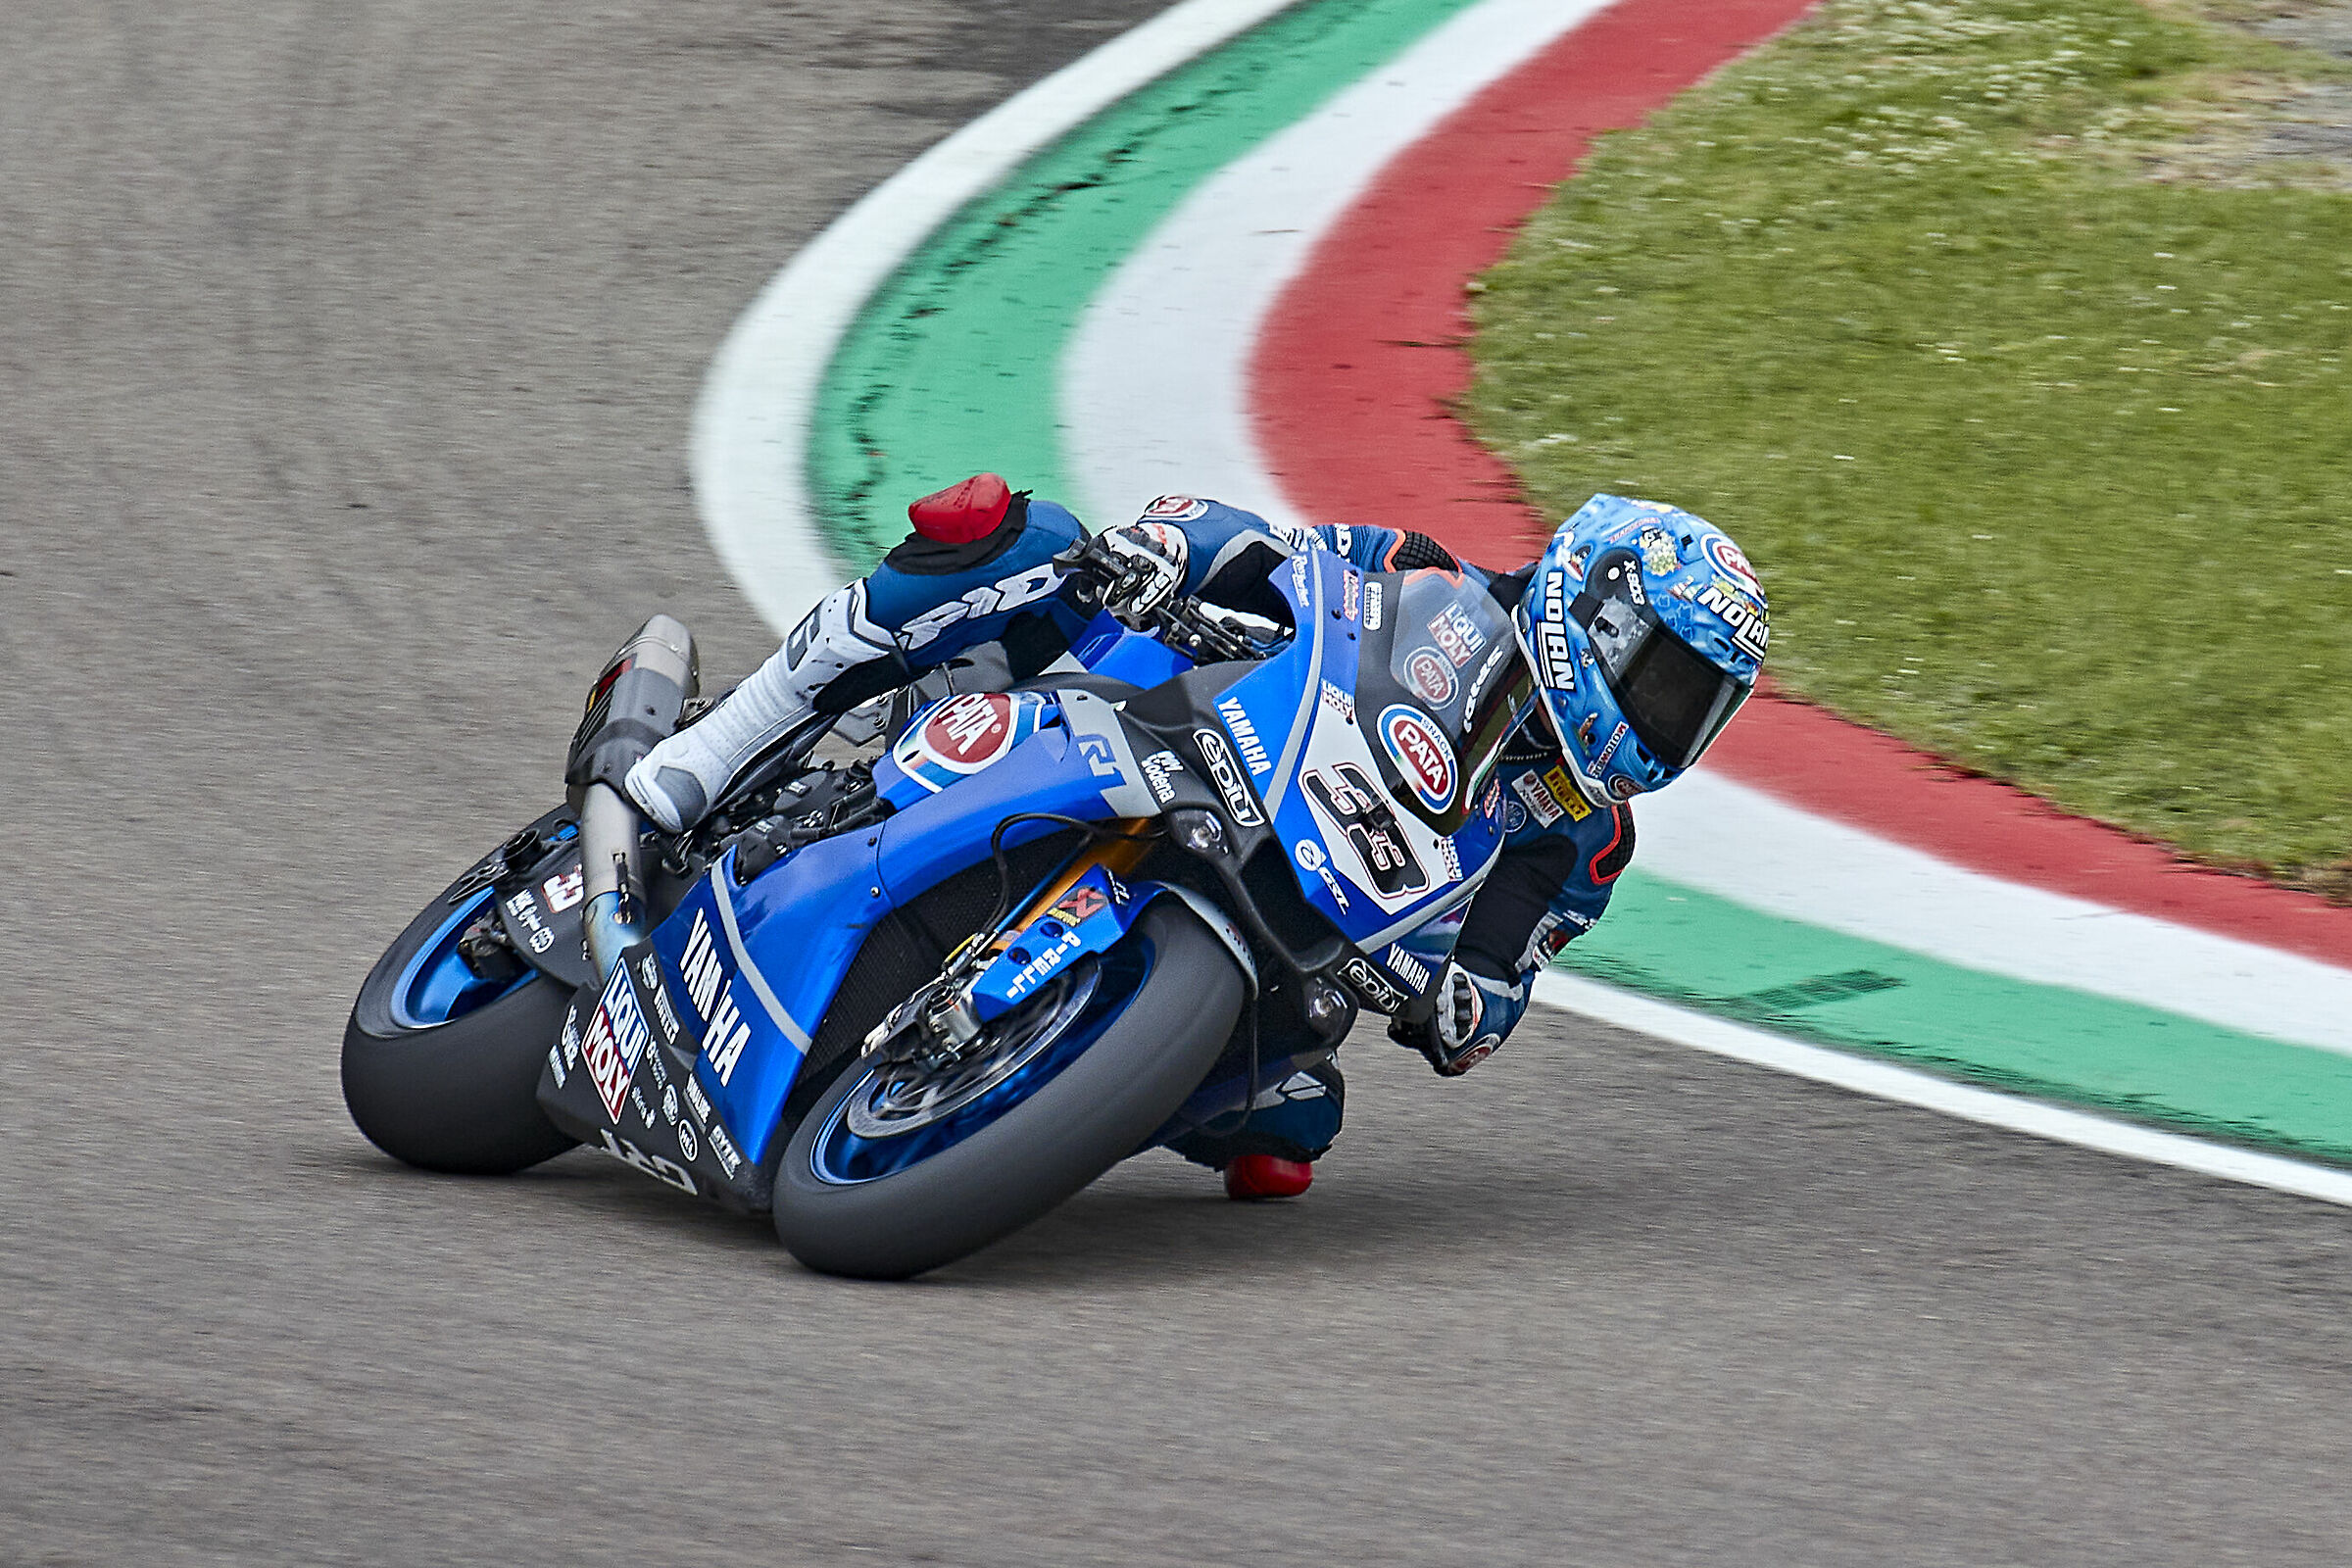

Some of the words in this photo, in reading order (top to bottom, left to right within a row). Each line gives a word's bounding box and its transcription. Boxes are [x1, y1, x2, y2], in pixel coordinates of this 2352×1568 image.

[1622, 560, 1646, 606] X-803
[1430, 615, 1471, 663] MOLY
[1445, 603, 1485, 654] LIQUI
[1538, 571, 1576, 691] NOLAN
[1321, 690, 1352, 717] MOLY
[1322, 678, 1353, 707] LIQUI
[1416, 660, 1446, 698] PATA
[938, 693, 999, 756] PATA
[1218, 697, 1272, 776] YAMAHA
[1422, 719, 1450, 760] SNACK
[1398, 723, 1445, 790] PATA
[1302, 762, 1431, 900] 33
[1006, 931, 1082, 999] PIRELLI
[1386, 942, 1431, 995] YAMAHA
[605, 967, 645, 1070] LIQUI
[680, 907, 752, 1087] YAMHA
[585, 1010, 628, 1109] MOLY
